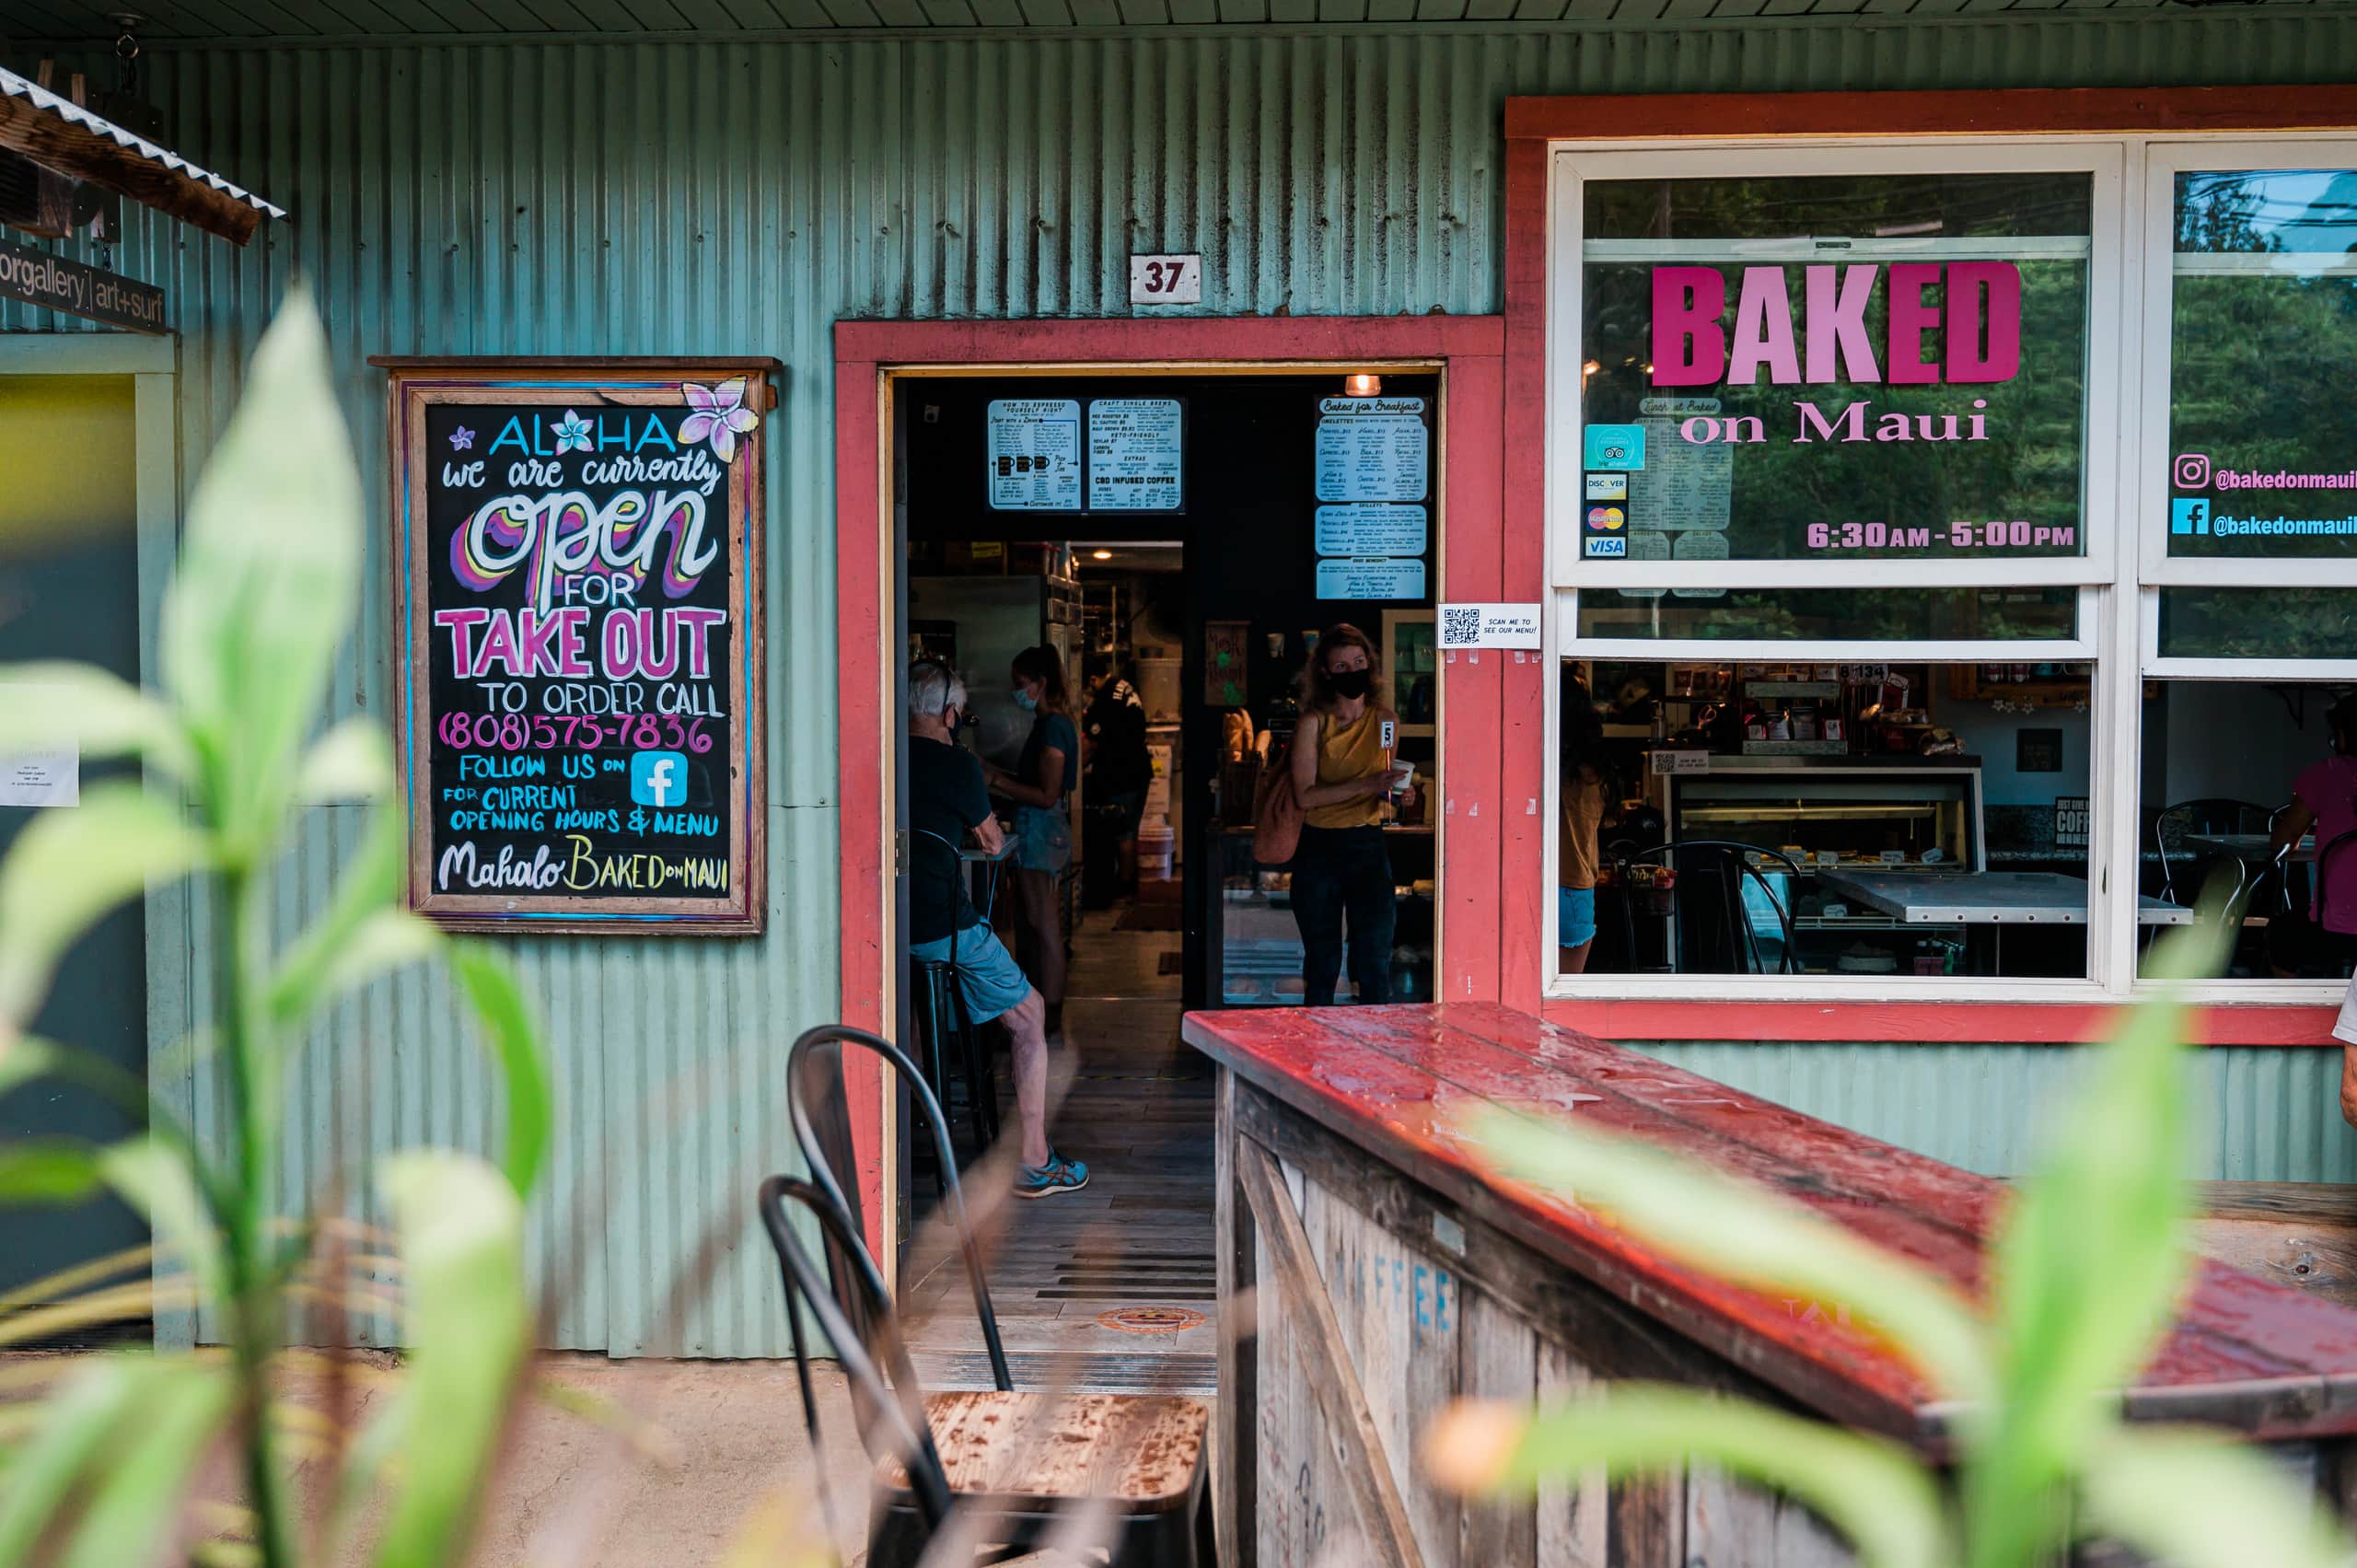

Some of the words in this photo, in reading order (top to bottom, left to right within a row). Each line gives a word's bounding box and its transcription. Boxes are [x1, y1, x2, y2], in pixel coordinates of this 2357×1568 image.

[1144, 261, 1185, 293] 37
[96, 281, 163, 322] art+surf
[1652, 261, 2021, 387] BAKED
[1323, 400, 1353, 412] Baked
[1355, 402, 1372, 414] for
[1375, 399, 1420, 414] Breakfast
[1679, 413, 1768, 445] on
[1793, 399, 1990, 444] Maui
[1686, 400, 1718, 412] Baked
[442, 459, 485, 488] we
[508, 459, 563, 488] are
[581, 449, 722, 496] currently
[2215, 470, 2357, 491] @bakedonmaui
[460, 490, 719, 621] open
[1591, 540, 1623, 553] VISA
[563, 573, 635, 607] FOR
[434, 606, 594, 679] TAKE
[601, 606, 727, 681] OUT
[476, 682, 528, 714] TO
[542, 682, 644, 714] ORDER
[656, 682, 727, 718] CALL
[438, 711, 714, 754] (808)575-7836
[1384, 726, 1391, 740] 5
[459, 754, 546, 782] FOLLOW
[563, 753, 597, 779] US
[443, 787, 479, 802] FOR
[482, 784, 576, 812] CURRENT
[449, 810, 544, 831] OPENING
[554, 810, 621, 831] HOURS
[627, 804, 651, 837] &
[654, 811, 719, 837] MENU
[438, 839, 564, 891] Mahalo
[564, 834, 666, 891] BAKED
[683, 856, 728, 892] MAUI
